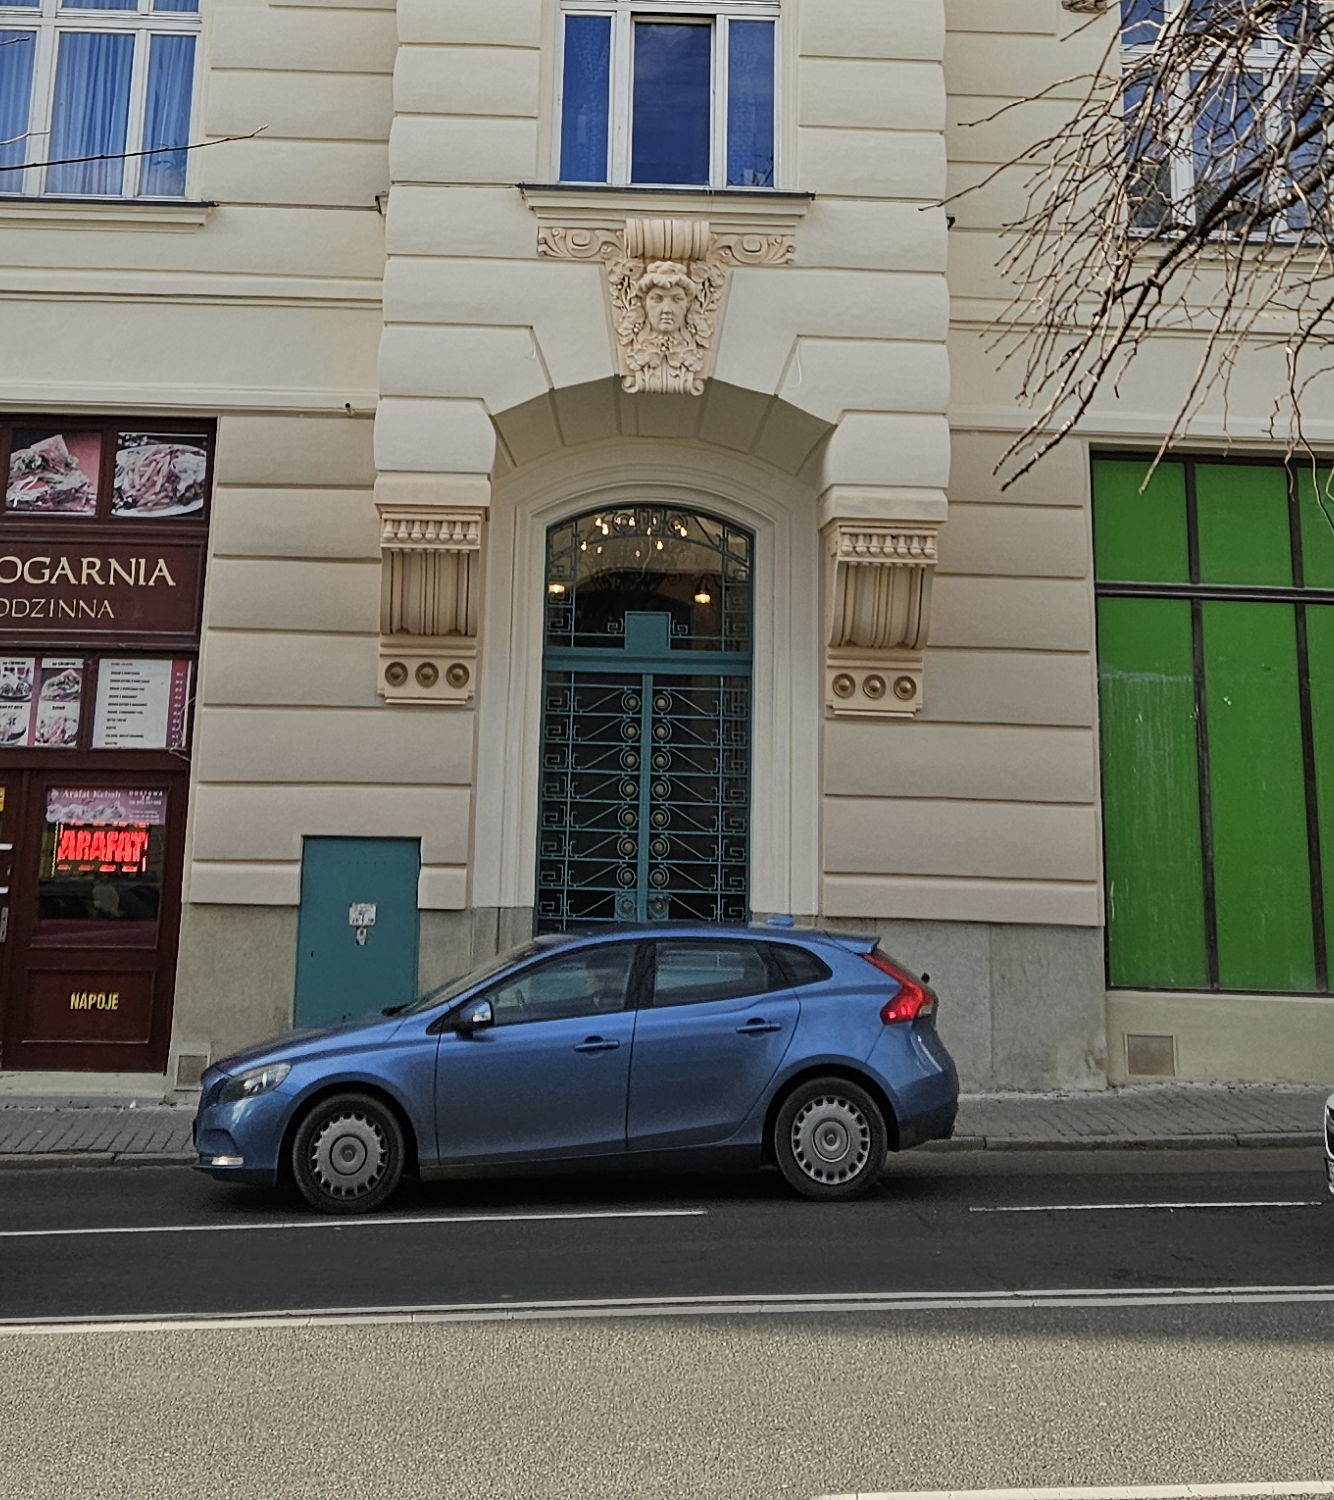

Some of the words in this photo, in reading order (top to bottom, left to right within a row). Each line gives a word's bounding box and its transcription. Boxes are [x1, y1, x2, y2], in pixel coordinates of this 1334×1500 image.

[62, 789, 90, 799] Arafat
[57, 830, 147, 862] ARAFAT
[70, 992, 119, 1010] NAPOJE
